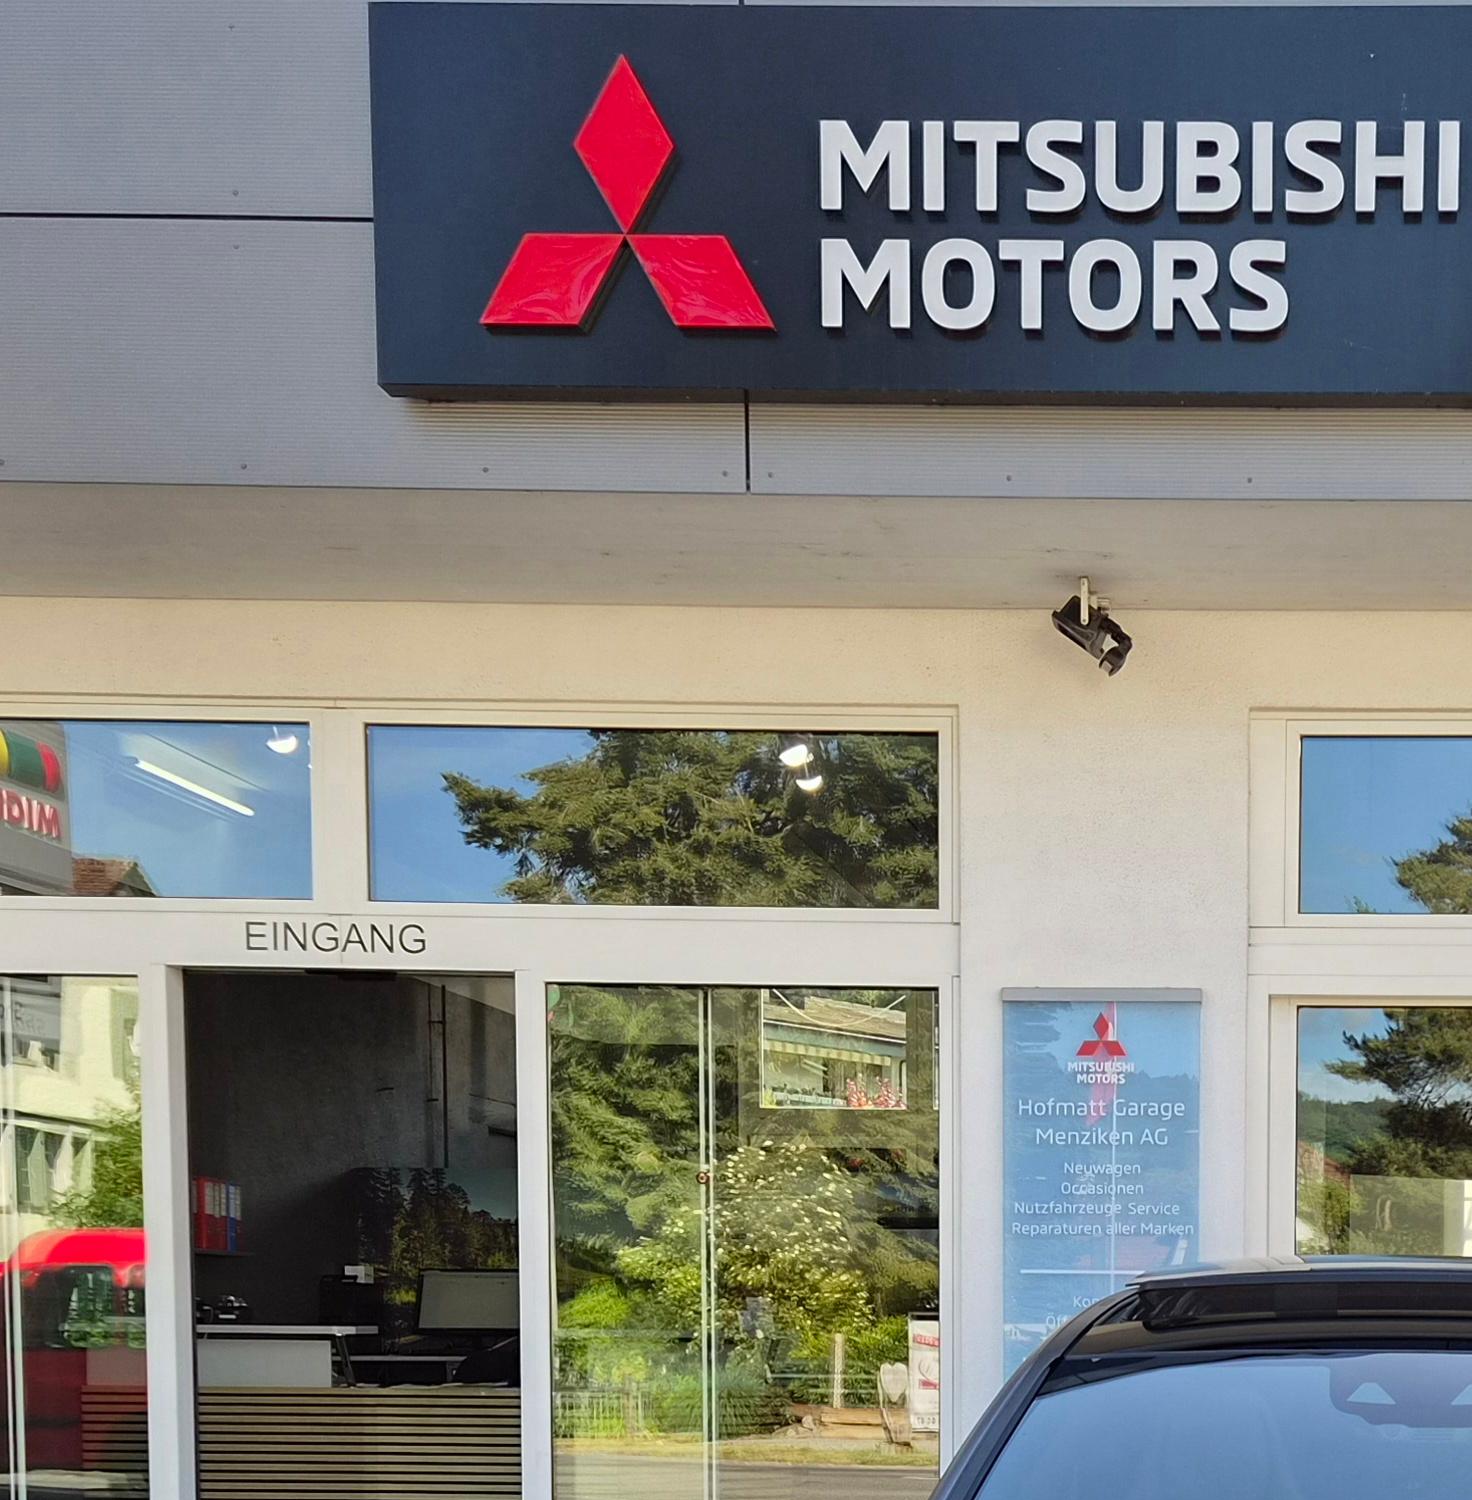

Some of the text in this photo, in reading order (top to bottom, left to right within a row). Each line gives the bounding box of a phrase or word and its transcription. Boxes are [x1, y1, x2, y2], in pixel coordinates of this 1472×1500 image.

[819, 118, 1460, 214] MITSUBISHI
[820, 237, 1289, 332] MOTORS
[245, 920, 427, 954] EINGANG
[1067, 1061, 1135, 1073] MITSUBISHI
[1076, 1073, 1127, 1084] MOTORS
[1018, 1098, 1186, 1121] Hofmatt Garage
[1036, 1127, 1169, 1146] Menziken AG
[1063, 1162, 1141, 1177] Neuwagen
[1060, 1182, 1144, 1196] Occasionen
[1014, 1201, 1181, 1217] Nutzfahrzeuge Service
[1012, 1222, 1195, 1237] Reparaturen aller Marken
